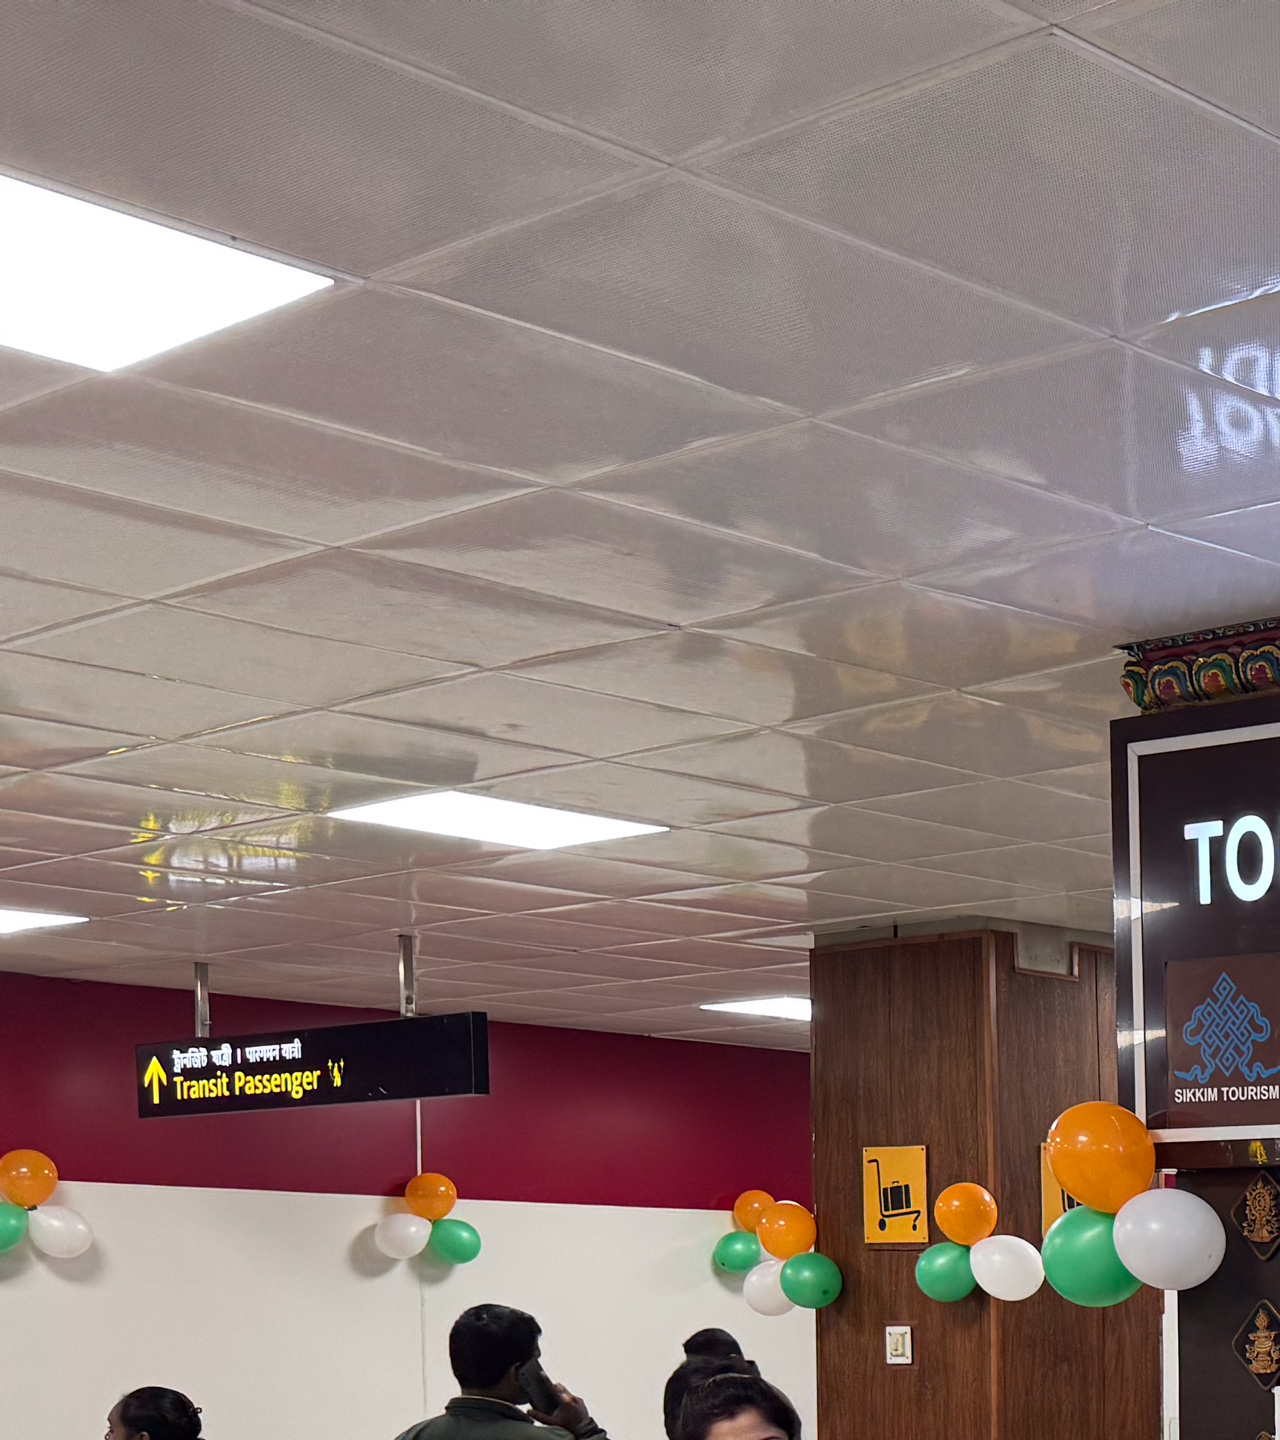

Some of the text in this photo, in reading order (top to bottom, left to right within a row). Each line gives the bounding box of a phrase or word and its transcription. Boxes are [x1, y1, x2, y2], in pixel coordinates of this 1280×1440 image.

[173, 1070, 322, 1100] Transit Passenger
[1174, 1084, 1280, 1103] SIKKIM TOURISM
